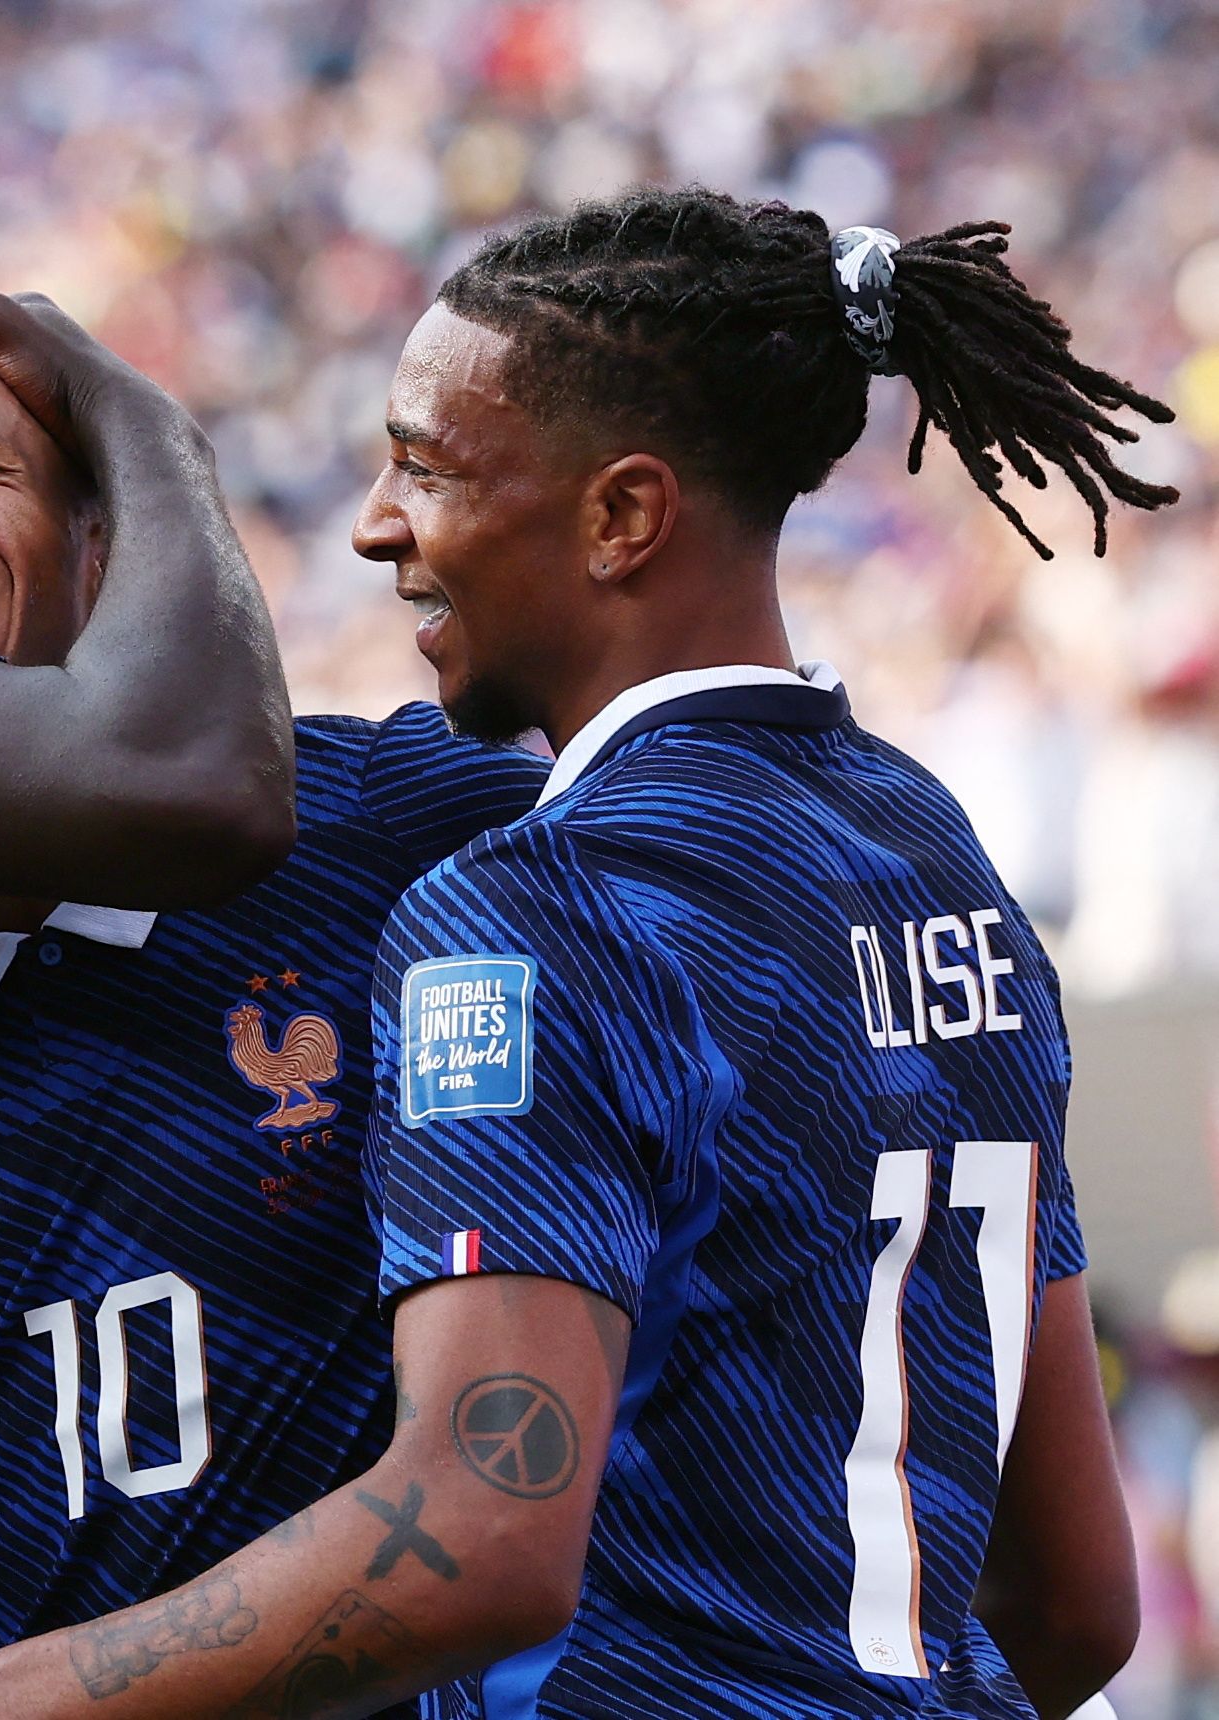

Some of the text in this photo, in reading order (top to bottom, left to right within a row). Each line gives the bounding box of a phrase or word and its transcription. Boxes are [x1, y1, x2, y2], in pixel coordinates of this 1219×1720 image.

[421, 979, 506, 1011] FOOTBALL
[851, 908, 1022, 1049] OLISE
[420, 1004, 507, 1044] UNITES
[415, 1037, 512, 1077] the World
[439, 1073, 476, 1091] FIFA
[24, 1271, 213, 1521] 10
[845, 1141, 1039, 1679] 11
